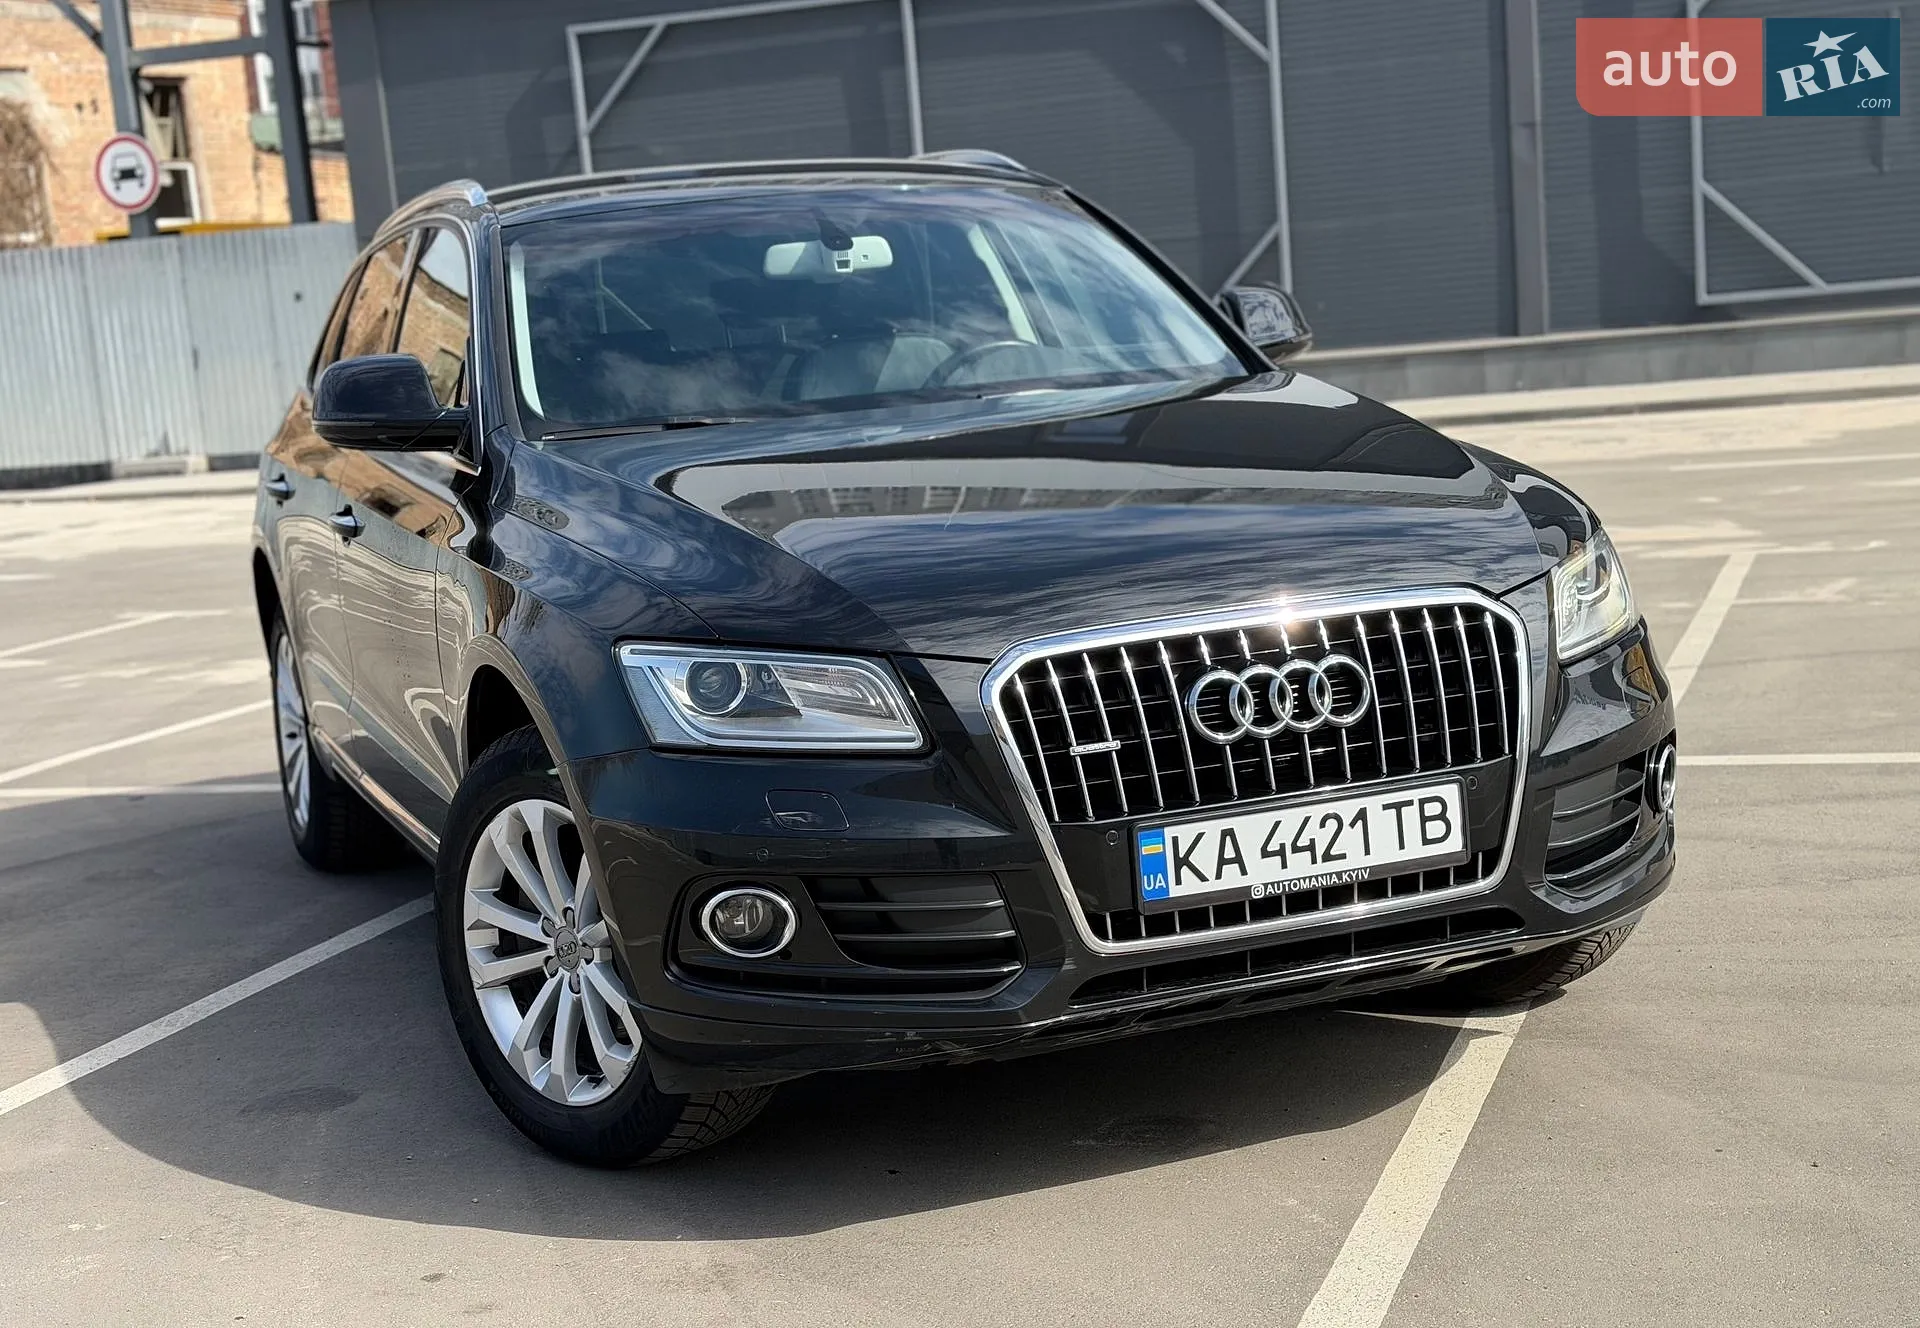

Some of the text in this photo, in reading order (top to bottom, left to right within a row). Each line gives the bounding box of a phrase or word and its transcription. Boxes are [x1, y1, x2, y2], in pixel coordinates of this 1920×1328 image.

[1171, 795, 1452, 886] KA 4421 TB
[1143, 873, 1167, 891] UA
